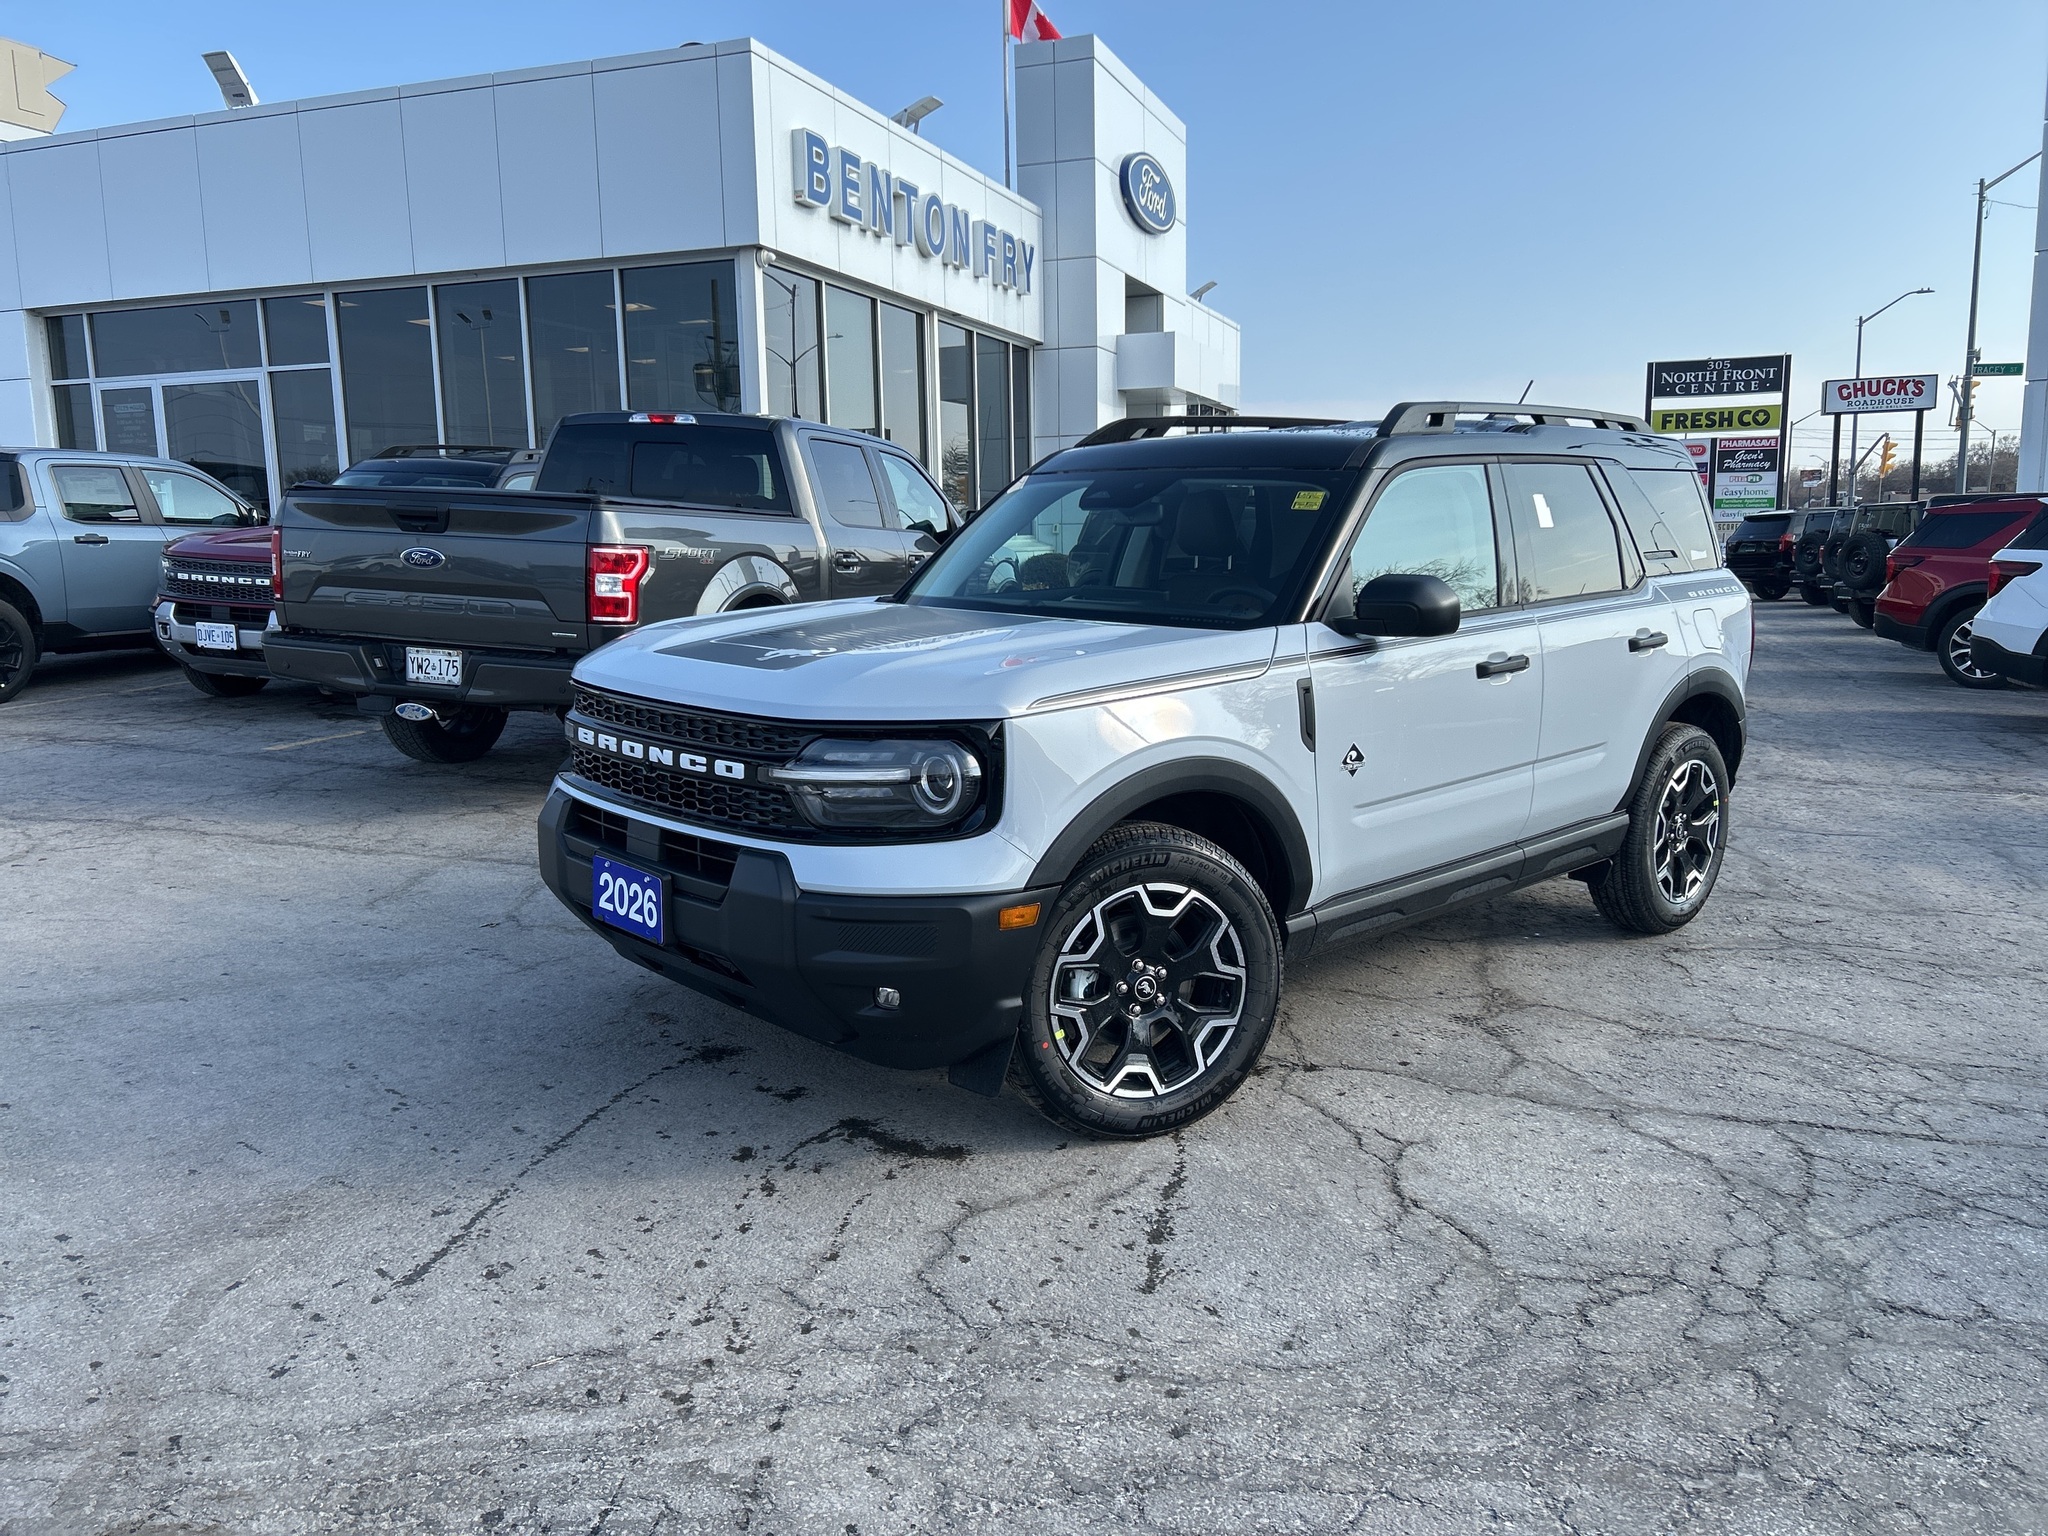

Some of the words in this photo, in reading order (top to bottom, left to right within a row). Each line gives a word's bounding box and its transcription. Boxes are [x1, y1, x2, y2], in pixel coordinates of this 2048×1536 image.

[1138, 164, 1167, 221] Ford
[794, 128, 970, 269] BENTON
[975, 220, 1035, 295] FRY
[1707, 361, 1731, 370] 305
[1974, 366, 2006, 374] TRACEY
[1661, 371, 1717, 384] NORTH
[1722, 367, 1777, 380] FRONT
[1675, 381, 1759, 394] CENTRE
[1838, 378, 1926, 400] CHUCK'S
[1847, 397, 1914, 408] ROADHOUSE
[1661, 411, 1734, 430] FRESH
[1720, 439, 1776, 448] PHARMASAVE
[1722, 459, 1771, 470] Pharmacy
[1722, 487, 1768, 498] easyhome
[409, 551, 434, 565] Ford
[659, 547, 721, 560] SPORT
[177, 572, 271, 586] BRONCO
[1688, 586, 1740, 598] BRONCO
[410, 656, 431, 675] YW2
[438, 658, 459, 677] 175
[578, 727, 745, 780] BRONCO
[1090, 853, 1167, 882] MICHELIN
[599, 872, 657, 928] 2026
